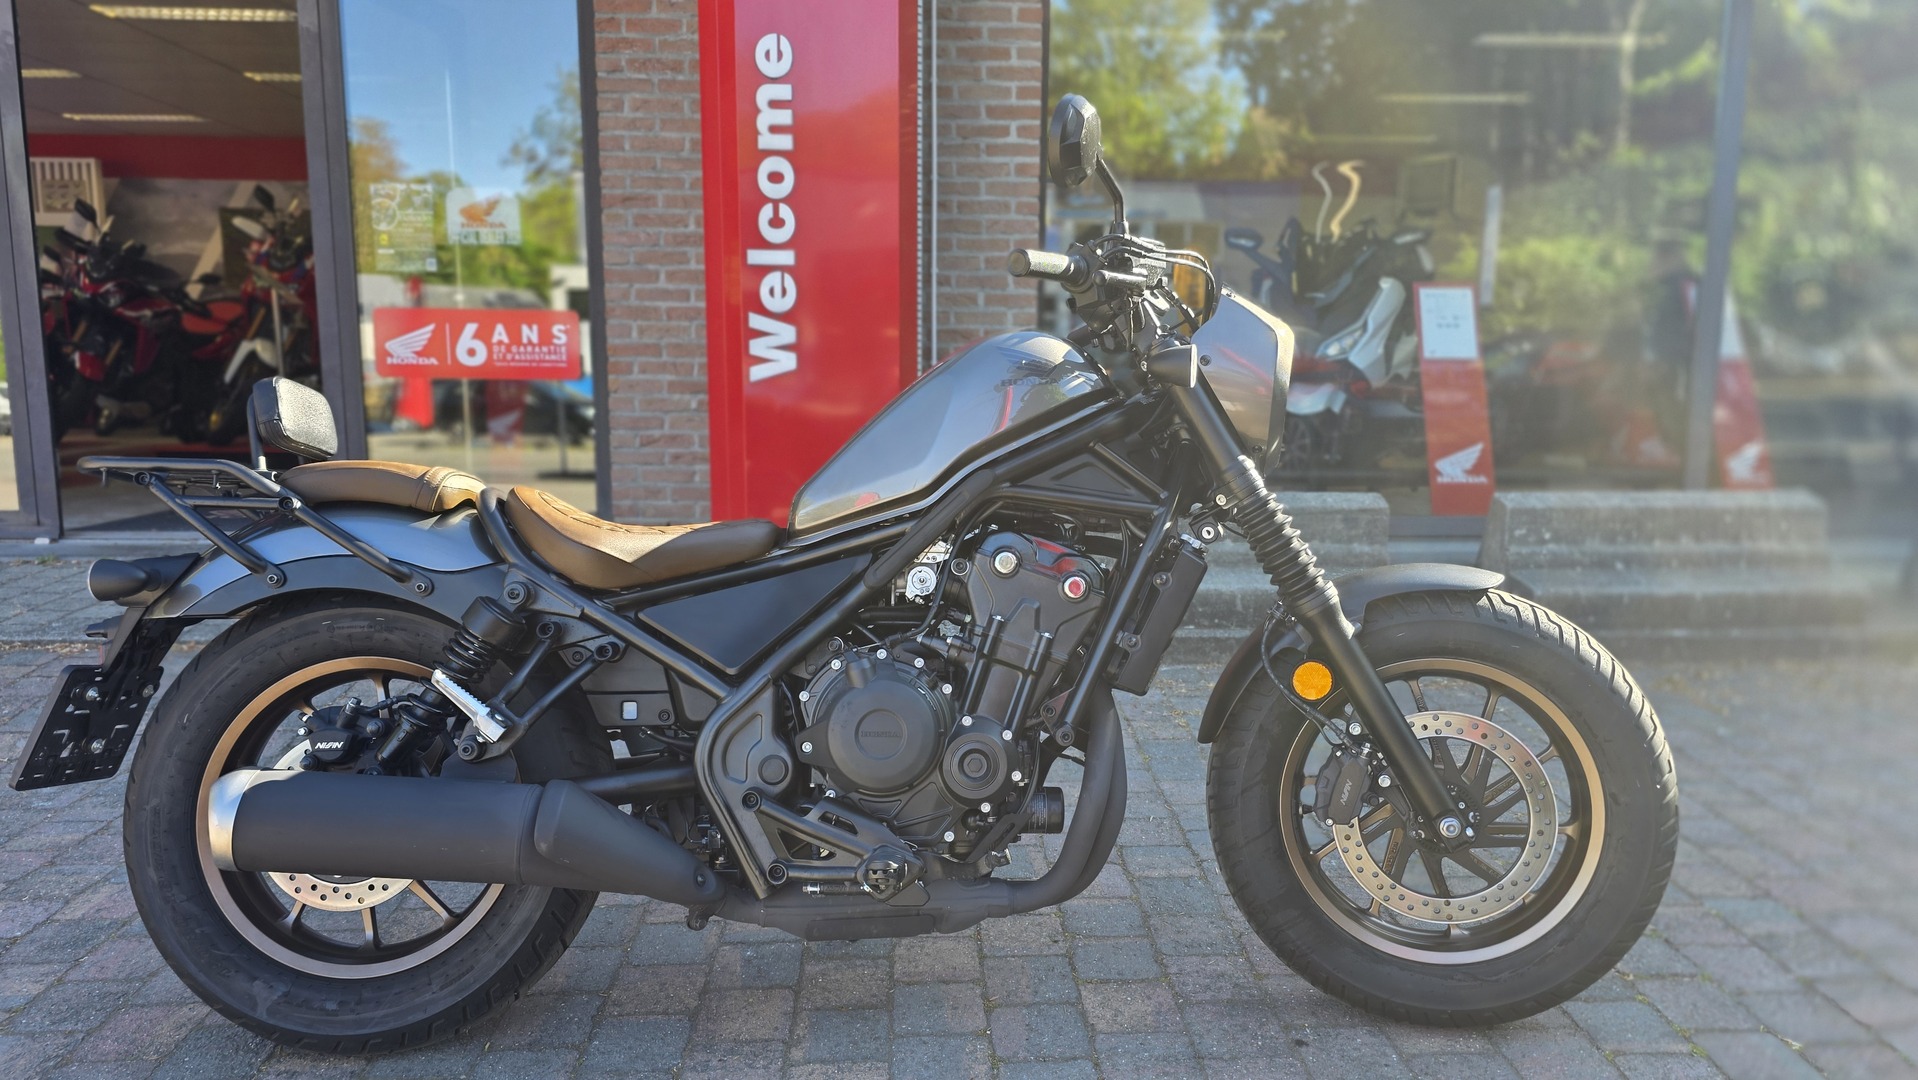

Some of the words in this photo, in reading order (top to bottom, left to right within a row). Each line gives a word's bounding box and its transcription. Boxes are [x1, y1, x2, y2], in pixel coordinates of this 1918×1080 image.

[746, 32, 798, 383] Welcome
[455, 322, 488, 367] 6
[493, 345, 506, 353] DE
[511, 345, 567, 354] GARANTIE
[386, 356, 439, 365] HONDA
[493, 353, 503, 361] ET
[506, 353, 567, 361] D'ASSISTANCE
[1000, 378, 1060, 387] HONDA
